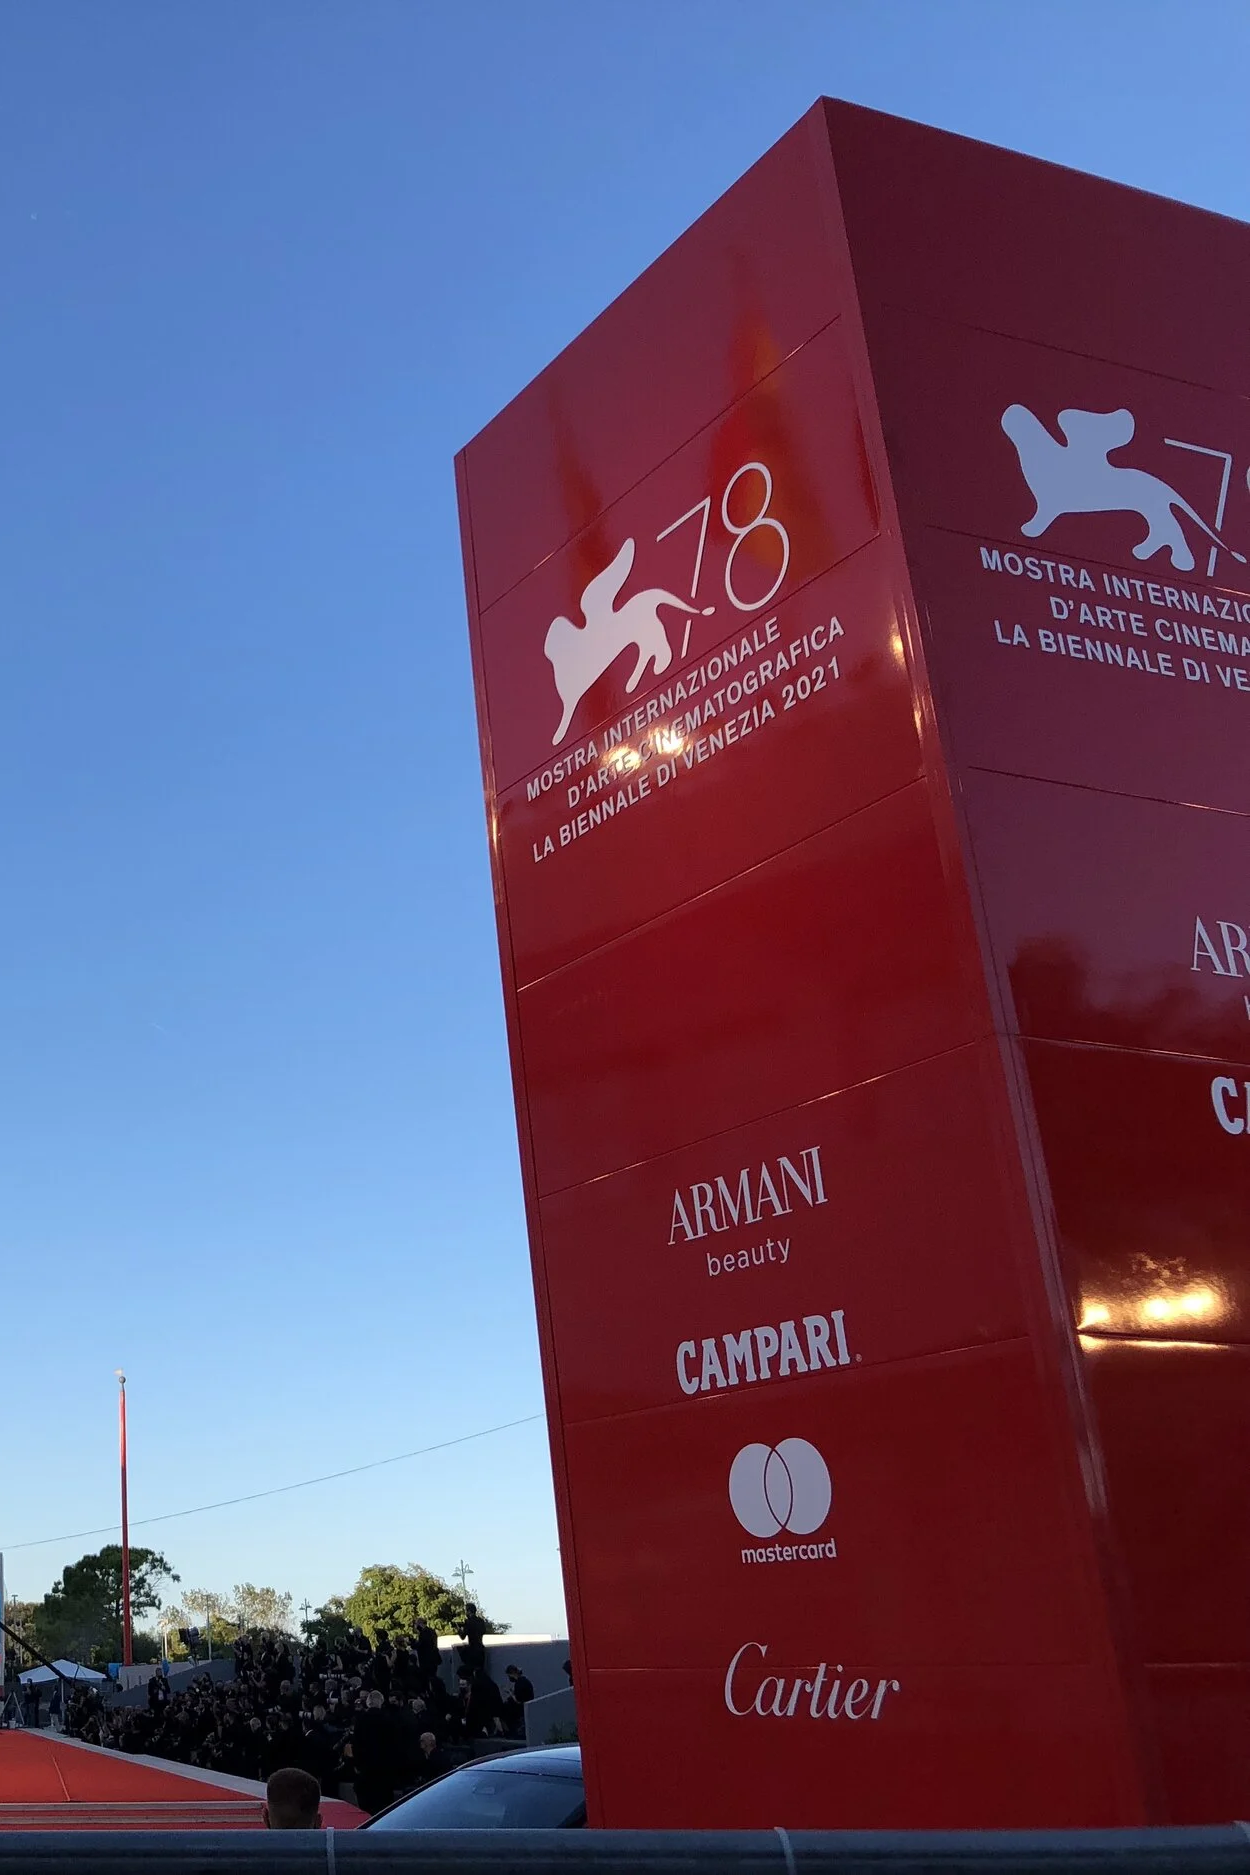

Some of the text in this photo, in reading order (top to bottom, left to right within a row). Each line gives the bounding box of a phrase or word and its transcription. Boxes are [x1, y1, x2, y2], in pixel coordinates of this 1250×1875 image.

[1164, 436, 1250, 577] 7
[656, 461, 790, 660] 78
[979, 546, 1096, 592] MOSTRA
[994, 620, 1030, 648] LA
[1038, 628, 1175, 678] BIENNALE
[1182, 657, 1210, 684] DI
[1050, 596, 1147, 638] D'ARTE
[526, 616, 781, 802] MOSTRA INTERNAZIONALE
[567, 615, 845, 808] D'ARTE CINEMATOGRAFICA
[532, 655, 841, 864] LA BIENNALE DI VENEZIA 2021
[1211, 1076, 1250, 1135] C
[667, 1145, 829, 1246] ARMANI
[705, 1237, 791, 1277] beauty
[675, 1309, 851, 1395] CAMPARI
[741, 1537, 837, 1564] mastercard
[724, 1641, 901, 1720] Cartier
